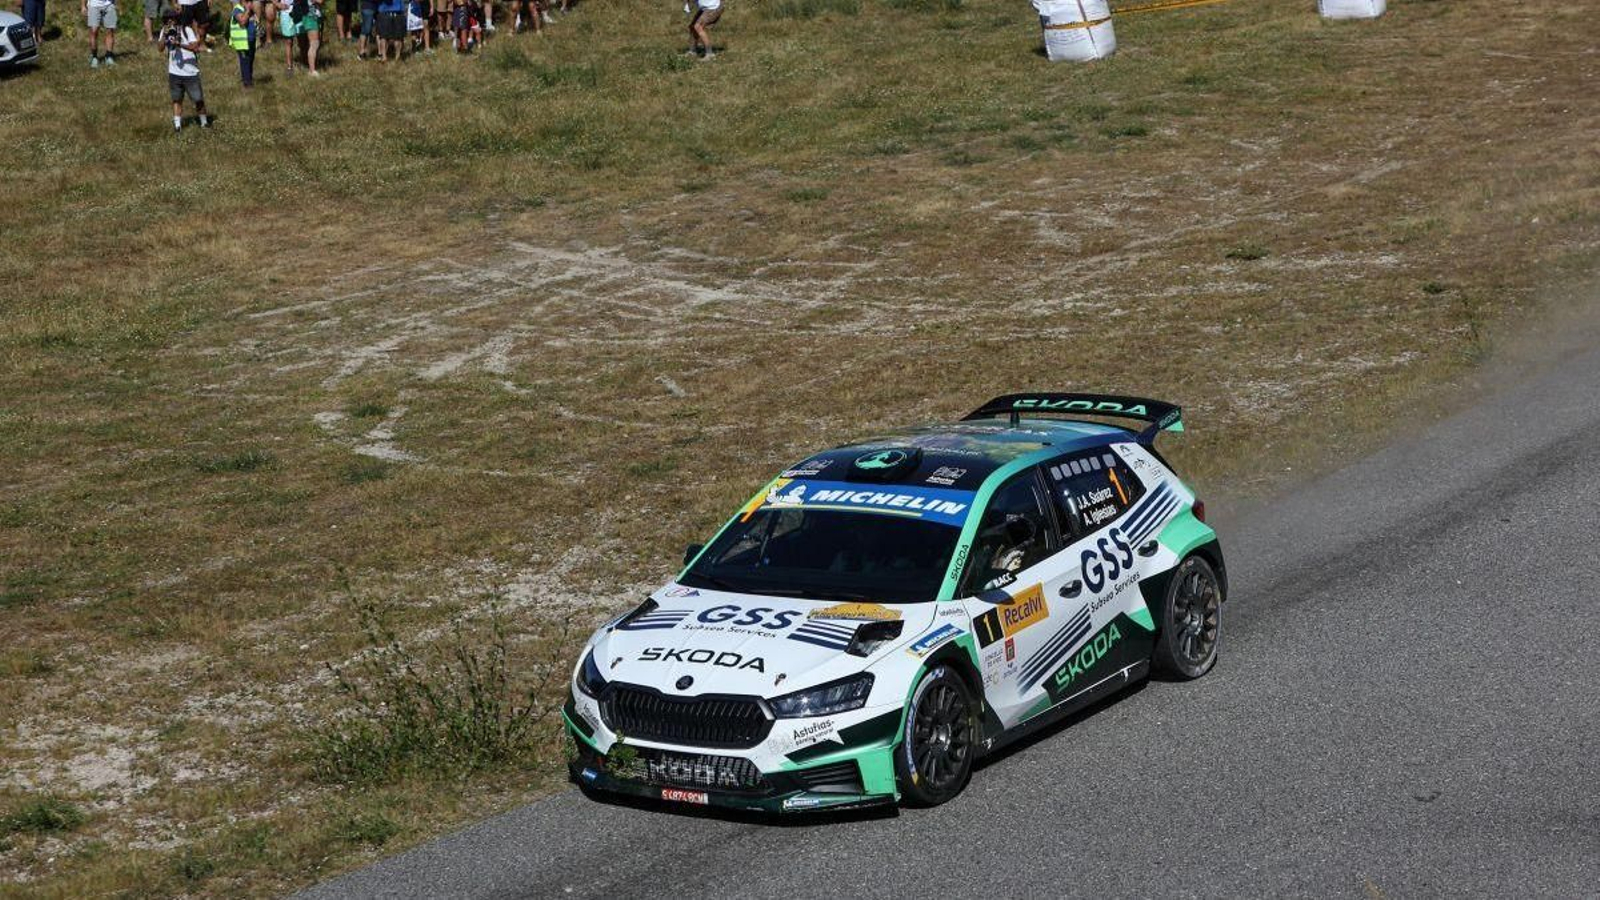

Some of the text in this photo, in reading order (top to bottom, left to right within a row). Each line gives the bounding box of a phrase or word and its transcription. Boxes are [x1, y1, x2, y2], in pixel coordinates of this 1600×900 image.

[1108, 467, 1128, 505] 1
[809, 489, 967, 515] MICHELIN
[1081, 527, 1134, 594] GSS
[1090, 571, 1141, 612] Subsea Services
[696, 604, 803, 630] GSS
[1004, 595, 1043, 627] Recalvi
[682, 623, 777, 639] Subsea Services
[983, 613, 995, 642] 1
[637, 648, 765, 674] SKODA
[1055, 623, 1122, 692] SKODA
